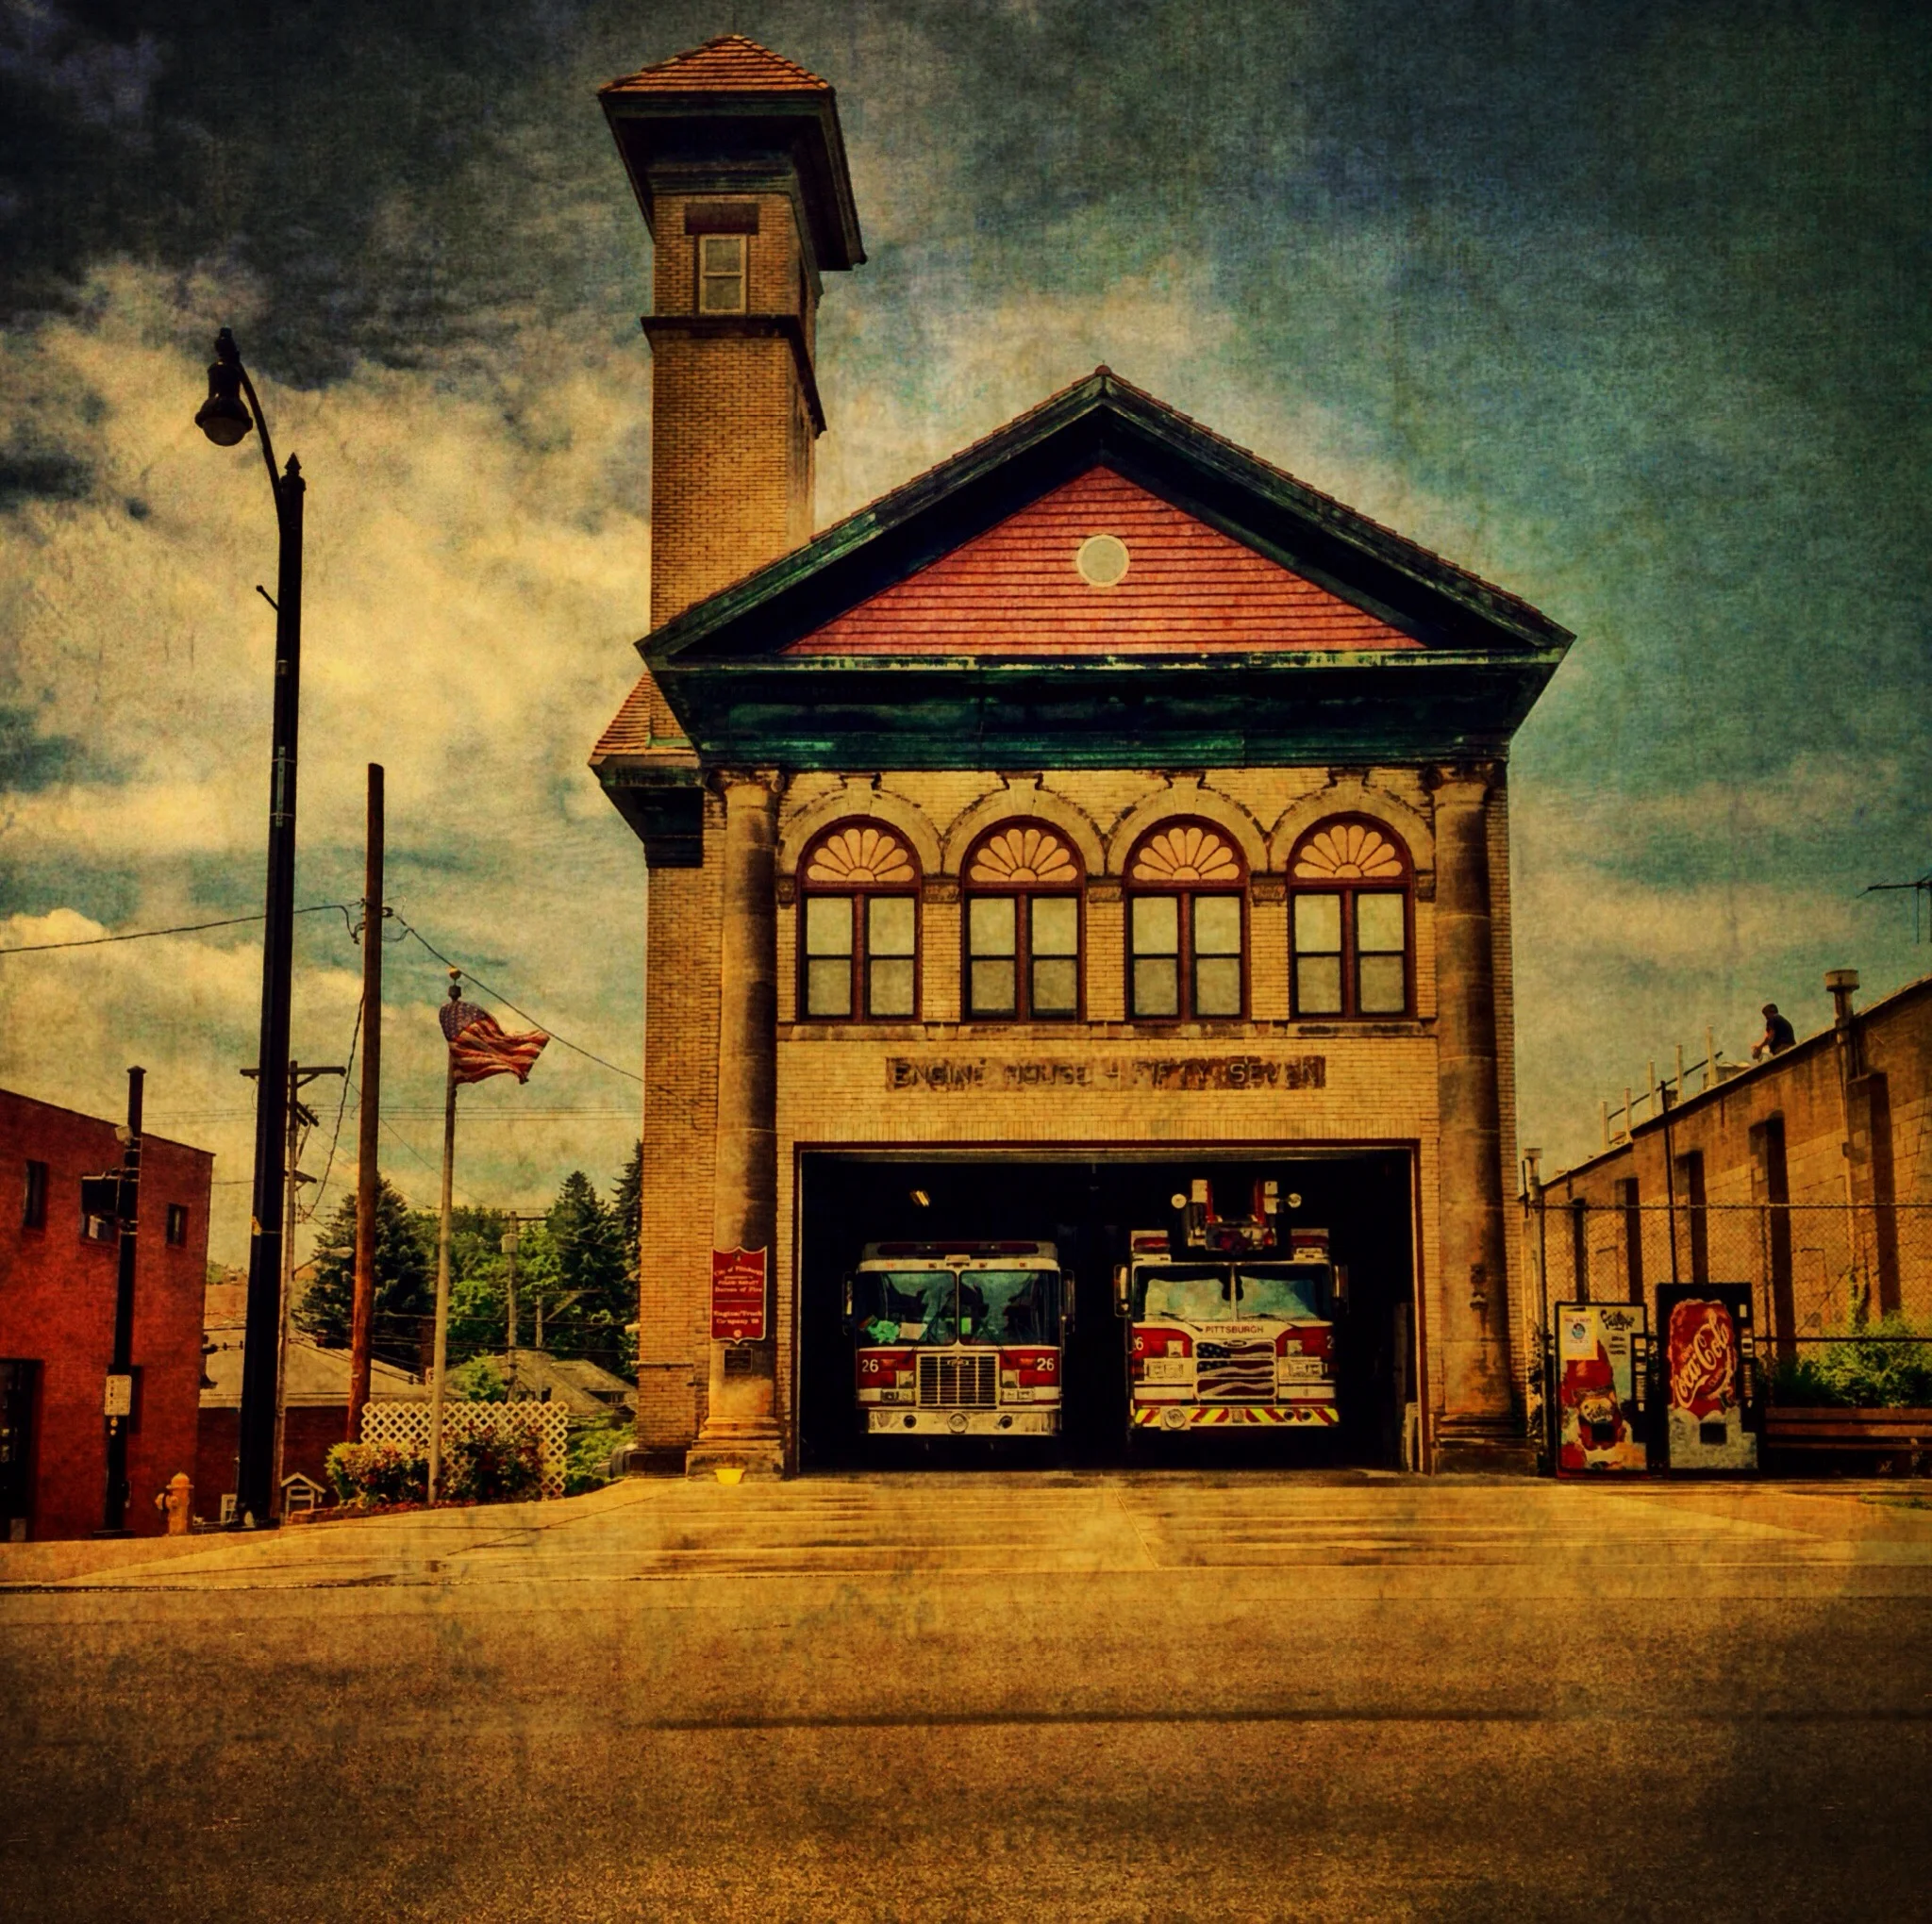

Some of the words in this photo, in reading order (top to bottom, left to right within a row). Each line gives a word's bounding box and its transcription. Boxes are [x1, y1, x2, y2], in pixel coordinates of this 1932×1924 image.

[894, 1062, 988, 1086] ENGINE
[1229, 1062, 1318, 1085] SEVEN
[1205, 1325, 1264, 1335] PITTSBURGH
[862, 1358, 879, 1373] 26
[1037, 1357, 1055, 1371] 26
